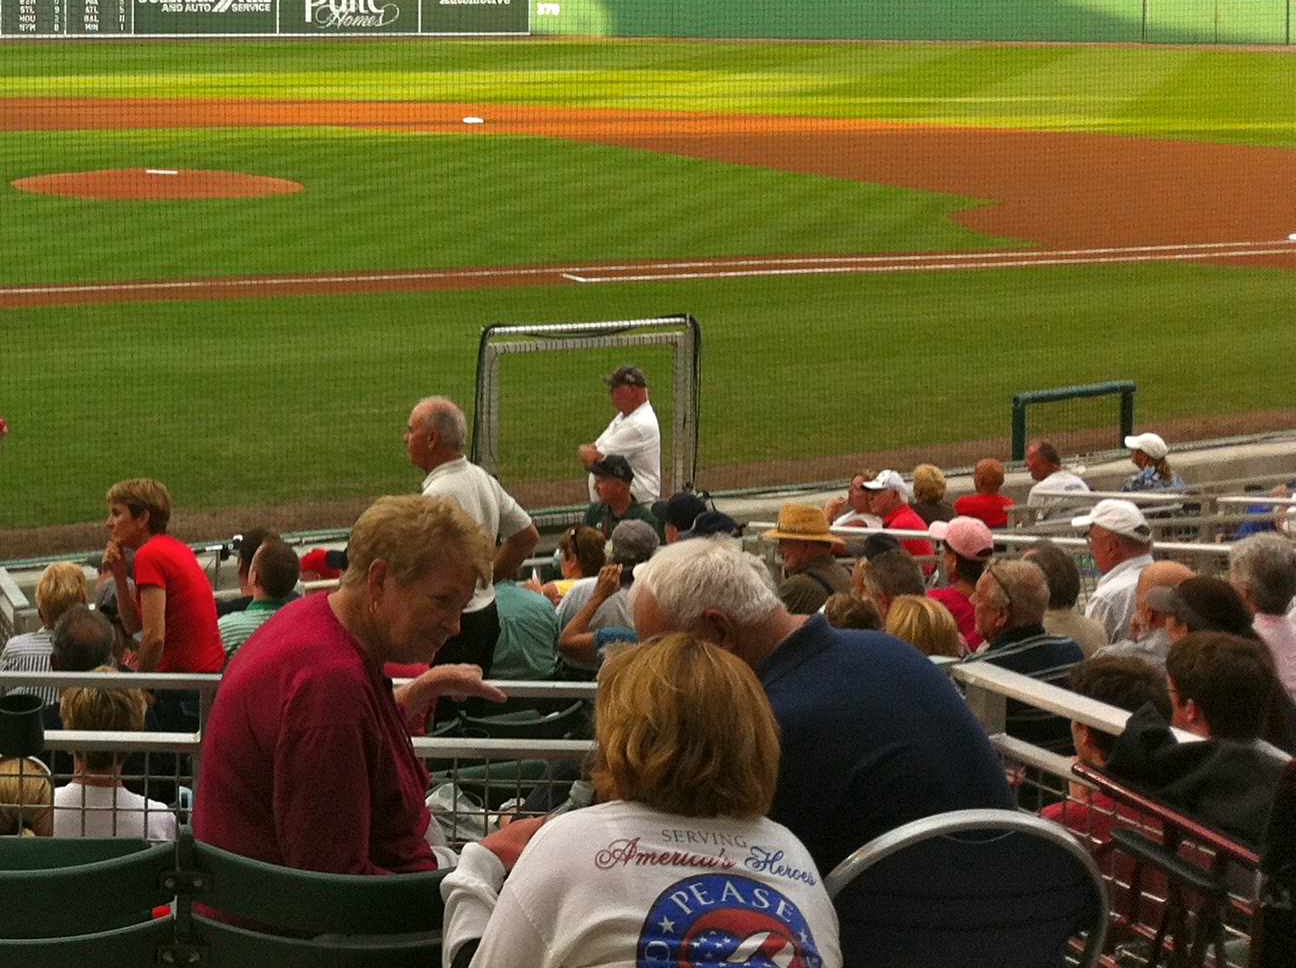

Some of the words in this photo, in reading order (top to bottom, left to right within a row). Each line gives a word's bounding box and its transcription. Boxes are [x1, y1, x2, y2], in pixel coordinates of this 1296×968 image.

[162, 3, 183, 12] AND
[185, 3, 211, 12] AUTO
[231, 3, 271, 12] SERVICE
[315, 3, 399, 30] Homes
[661, 829, 747, 848] SERVING
[595, 837, 736, 871] America's
[744, 845, 817, 887] Heroes
[668, 880, 797, 924] PEASE
